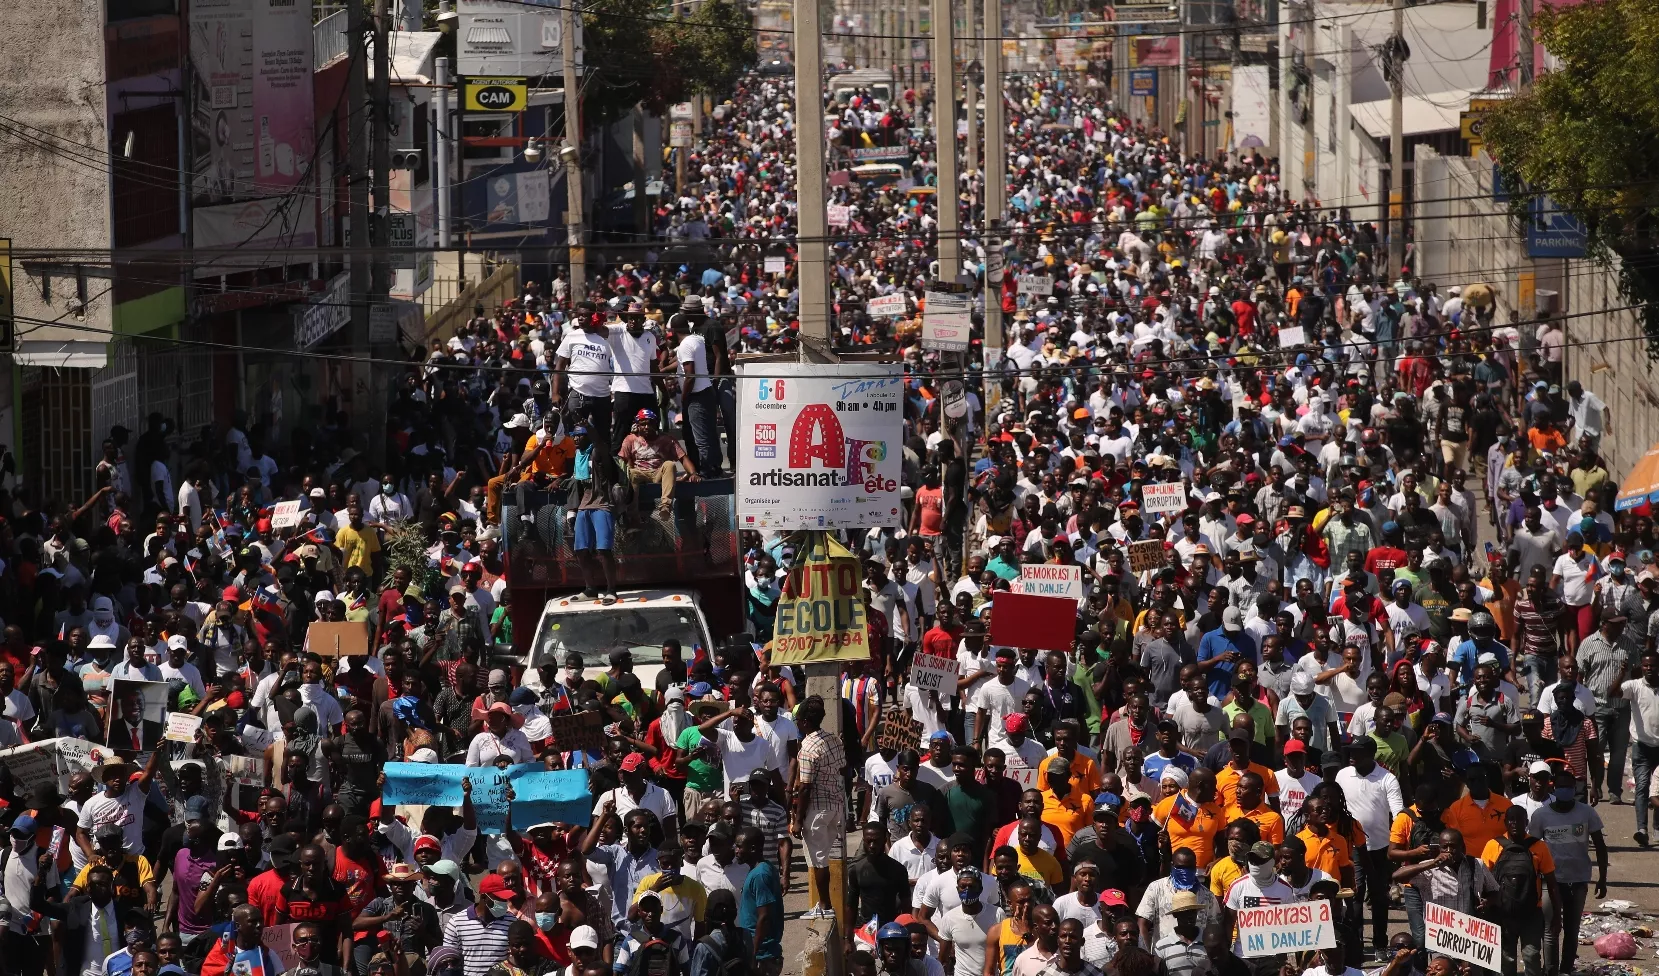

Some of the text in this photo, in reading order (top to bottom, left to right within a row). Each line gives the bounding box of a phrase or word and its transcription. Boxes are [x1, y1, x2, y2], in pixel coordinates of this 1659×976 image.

[480, 92, 510, 103] CAM
[1535, 237, 1579, 248] PARKING
[583, 344, 603, 352] ABA
[755, 402, 787, 410] décembre
[836, 401, 897, 413] 9h am 4h pm
[756, 430, 776, 440] 500
[750, 468, 838, 487] artisanat
[1146, 496, 1182, 508] CORRUPTION
[1023, 567, 1079, 581] DEMOKRASI A
[1025, 582, 1036, 593] AN
[777, 598, 863, 635] ECOLE
[916, 670, 943, 689] RACIST
[1024, 771, 1032, 784] A
[1426, 904, 1456, 928] LALIME
[1248, 933, 1264, 951] AN
